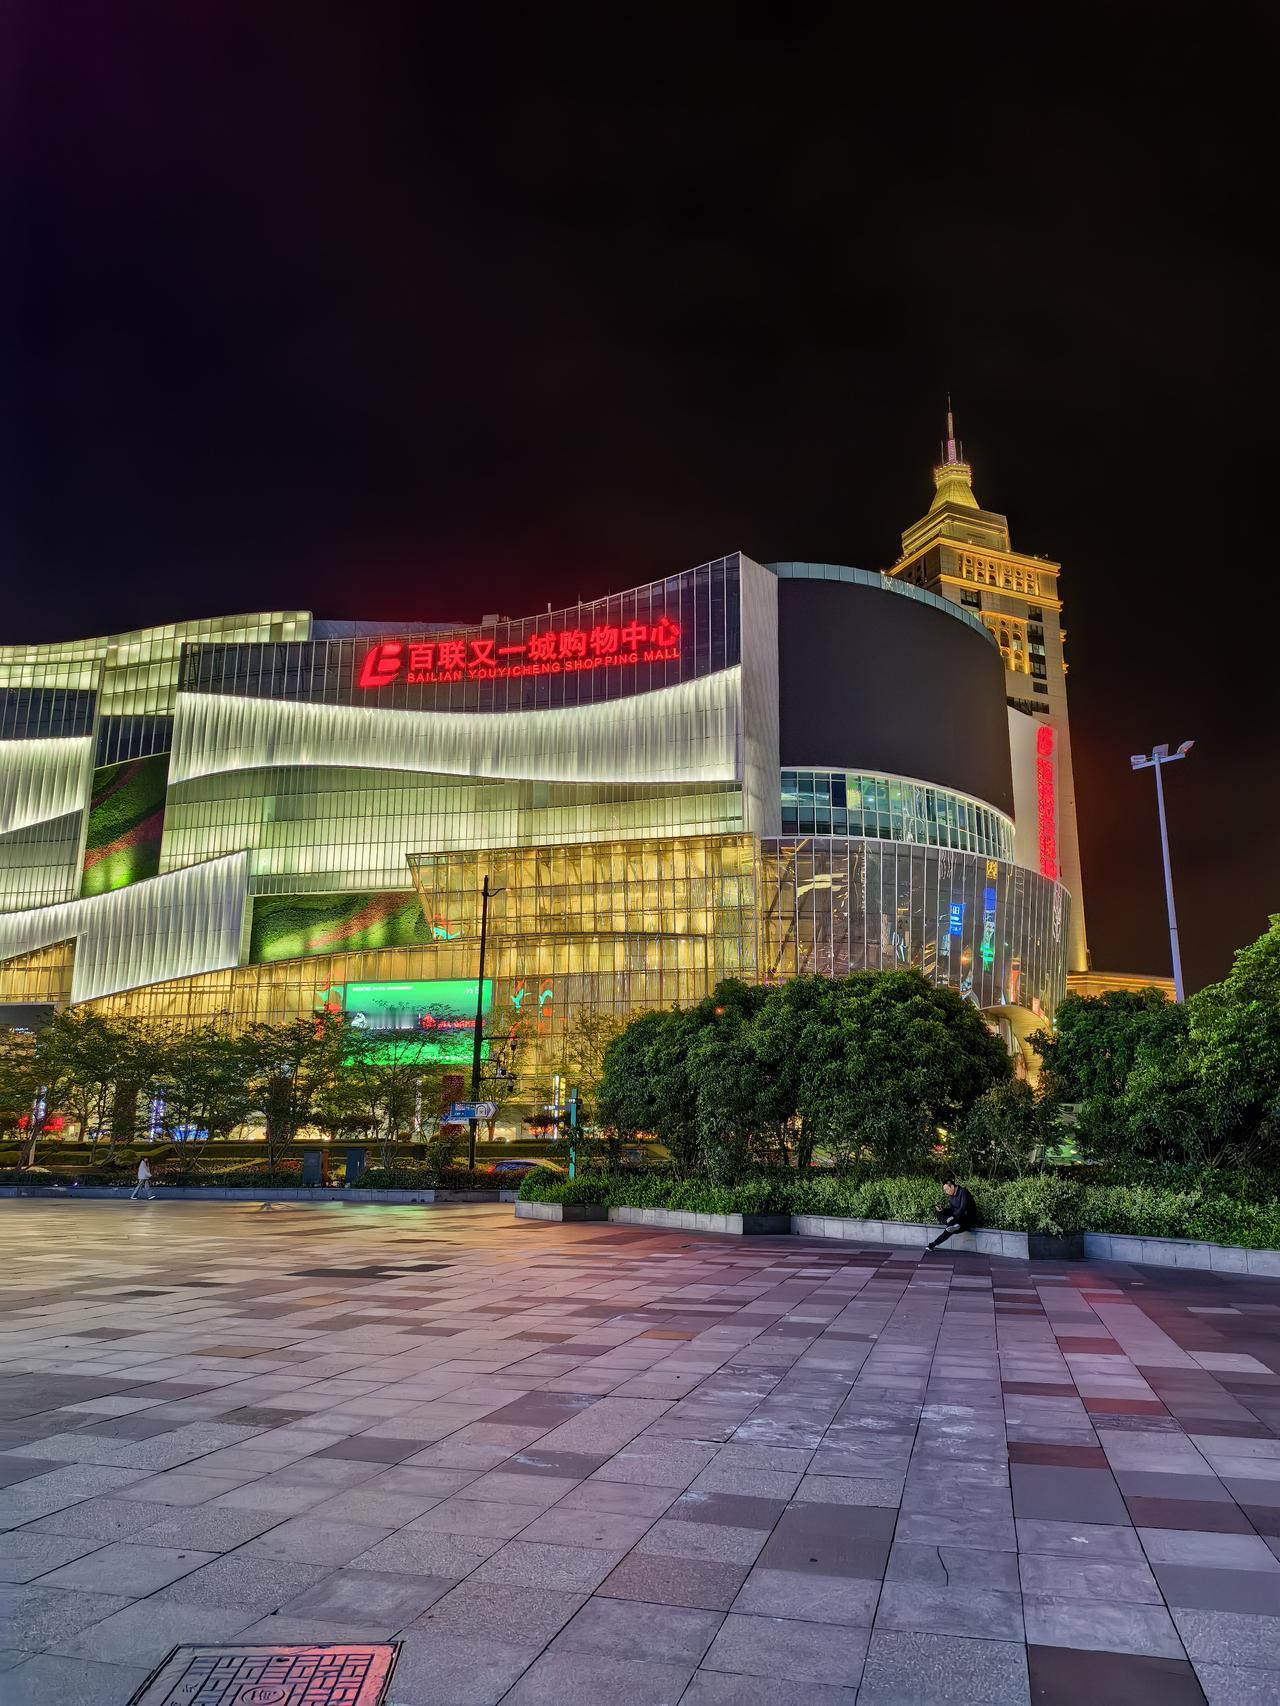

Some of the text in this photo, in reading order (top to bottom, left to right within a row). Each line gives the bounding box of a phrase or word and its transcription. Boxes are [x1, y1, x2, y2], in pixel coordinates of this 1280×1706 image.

[407, 647, 680, 683] BAILIAN YOUYICHENG SHOPPING MALL
[408, 616, 680, 670] 百联又一城购物中心
